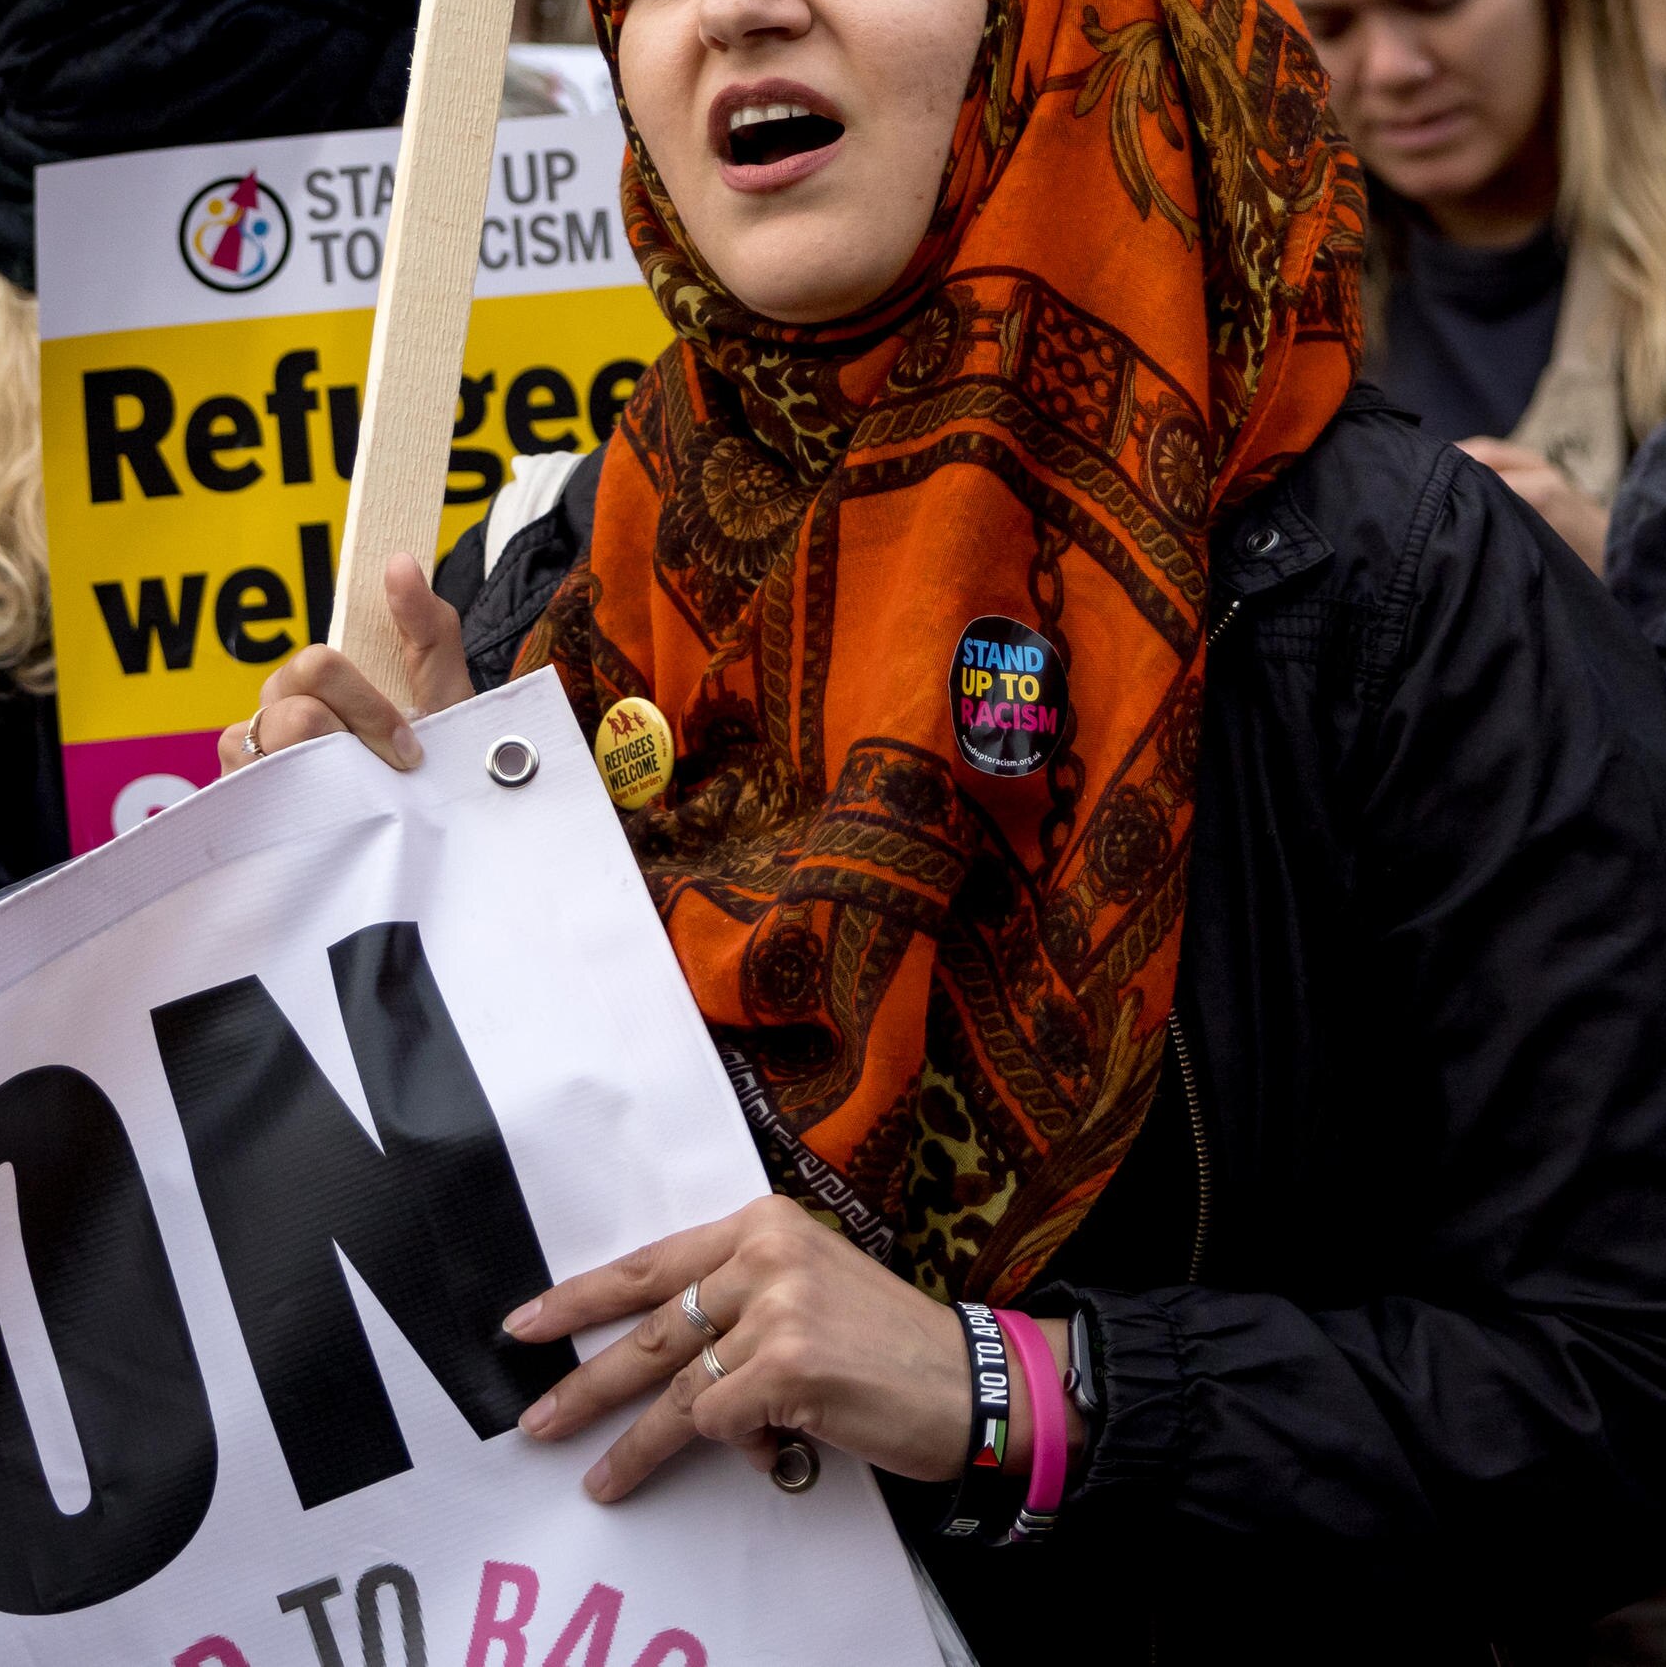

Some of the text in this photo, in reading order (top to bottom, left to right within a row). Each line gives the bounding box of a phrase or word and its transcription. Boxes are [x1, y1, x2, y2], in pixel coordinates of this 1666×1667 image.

[303, 147, 580, 223] STA UP
[309, 207, 614, 286] TO CISM
[962, 636, 1045, 674] STAND
[961, 666, 1041, 703] UP TO
[960, 697, 1059, 735] RACISM
[603, 732, 656, 773] REFUGEES
[961, 734, 1043, 768] standuptoracism.org.uk
[607, 752, 661, 793] WELCOME
[976, 1341, 1005, 1366] TO
[979, 1371, 1008, 1405] NO
